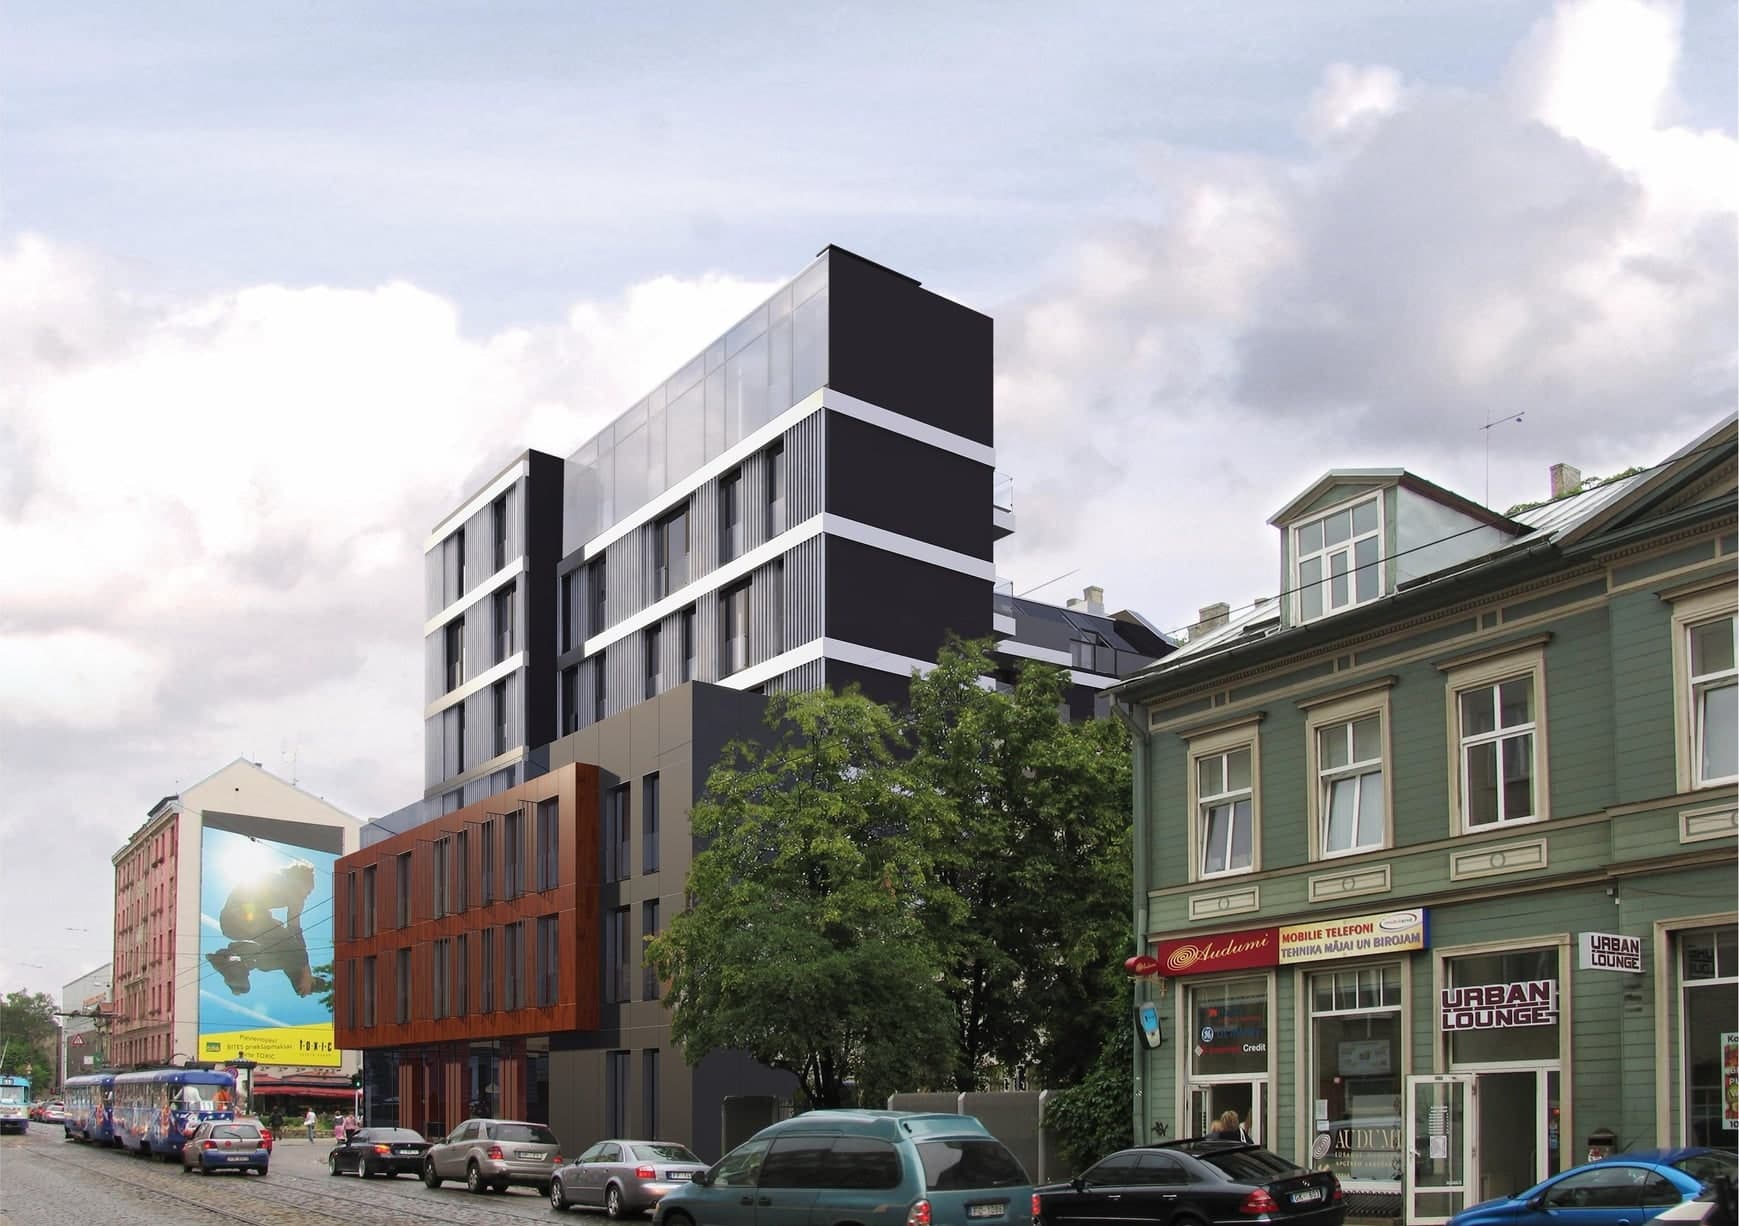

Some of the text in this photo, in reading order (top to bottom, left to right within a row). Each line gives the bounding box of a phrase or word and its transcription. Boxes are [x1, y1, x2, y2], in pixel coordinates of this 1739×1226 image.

[1282, 923, 1374, 944] MOBILIE TELEFONI
[1591, 935, 1639, 953] URBAN
[1196, 933, 1270, 961] Audumi
[1281, 944, 1322, 958] TEHNIKA
[1356, 938, 1371, 950] UN
[1374, 932, 1420, 948] BIROJAM
[1592, 954, 1639, 969] LOUNGE
[1442, 981, 1551, 1008] URBAN
[1442, 1006, 1551, 1030] LOUNGE
[1243, 1043, 1266, 1053] Credit
